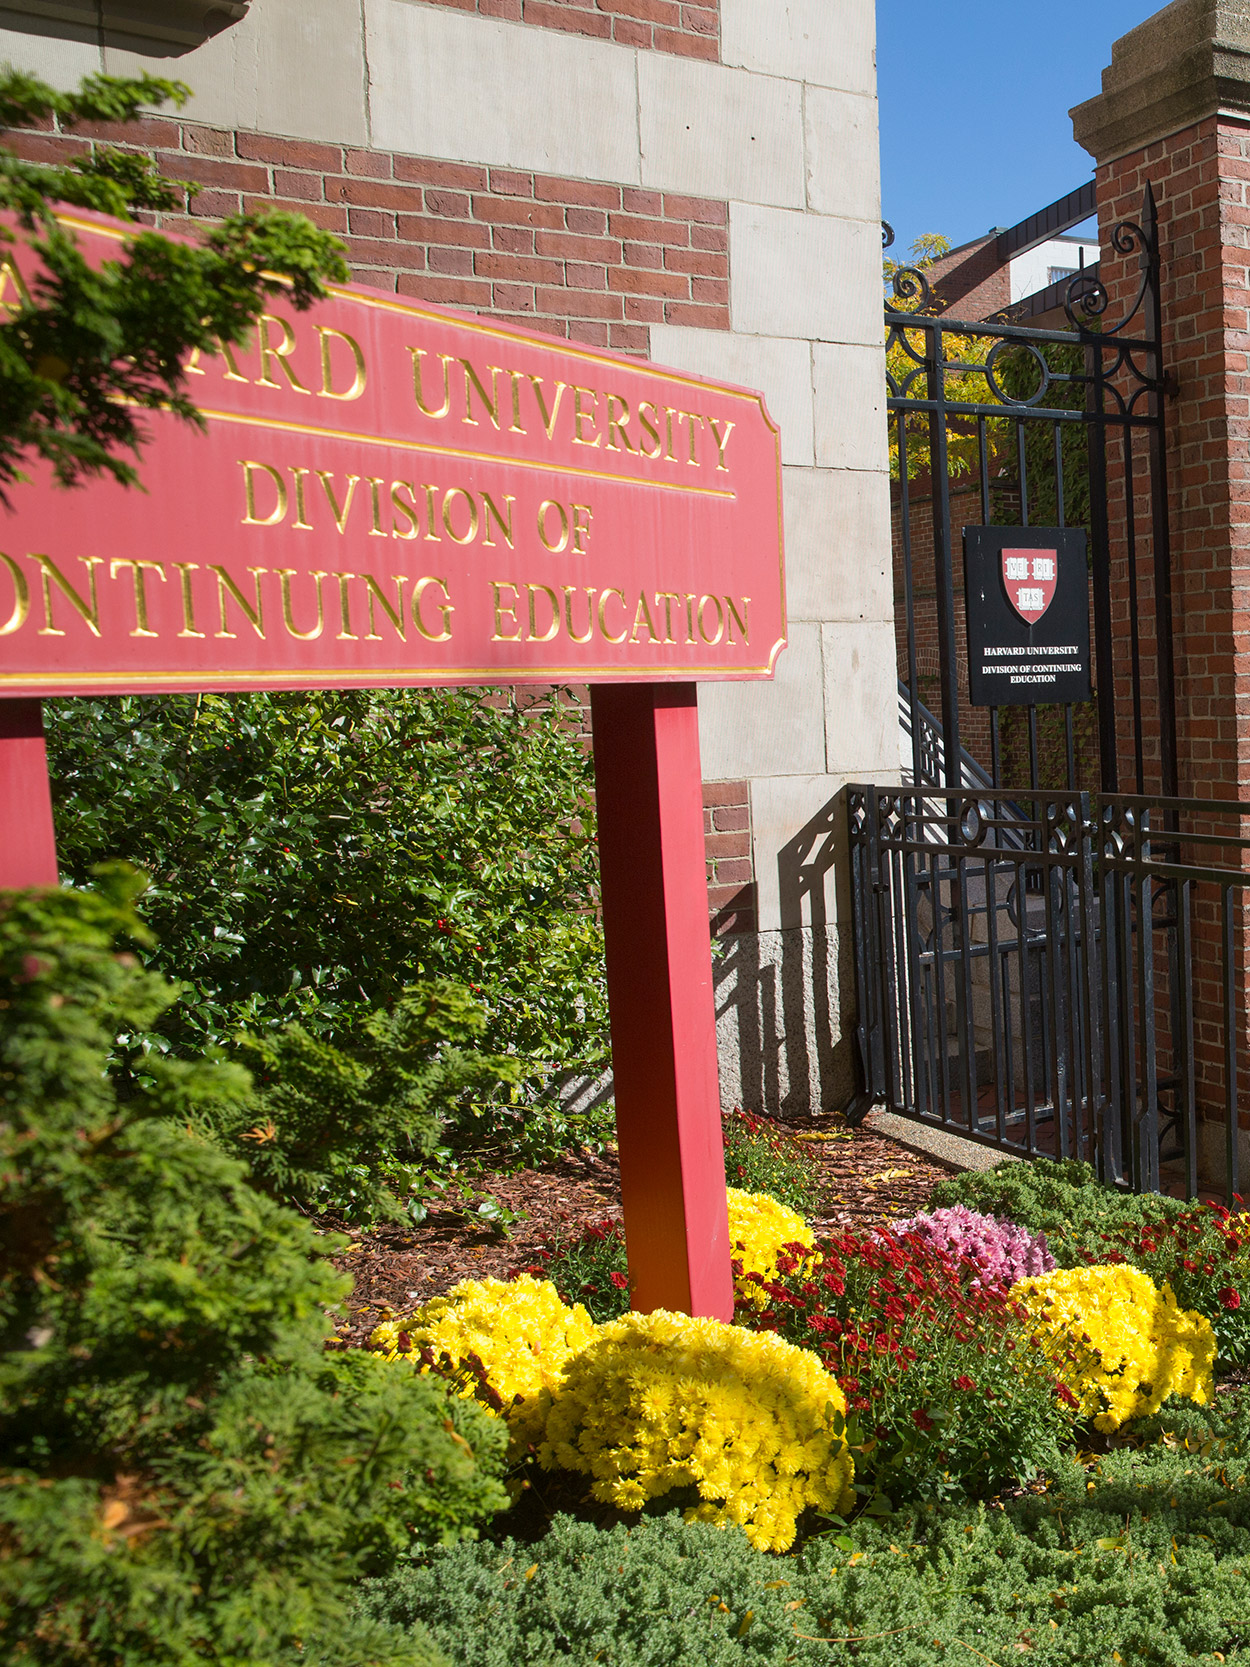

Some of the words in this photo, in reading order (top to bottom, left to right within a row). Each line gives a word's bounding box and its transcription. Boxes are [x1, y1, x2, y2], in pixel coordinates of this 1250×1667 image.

[405, 345, 736, 473] UNIVERSITY
[236, 460, 516, 550] DIVISION
[536, 499, 594, 555] OF
[1023, 592, 1039, 602] TAS
[487, 577, 752, 647] EDUCATION
[983, 646, 1025, 656] HARVARD
[1026, 645, 1079, 655] UNIVERSITY
[982, 665, 1018, 675] DIVISION
[1019, 665, 1032, 674] OF
[1032, 663, 1082, 673] CONTINUING
[1010, 674, 1056, 684] EDUCATION
